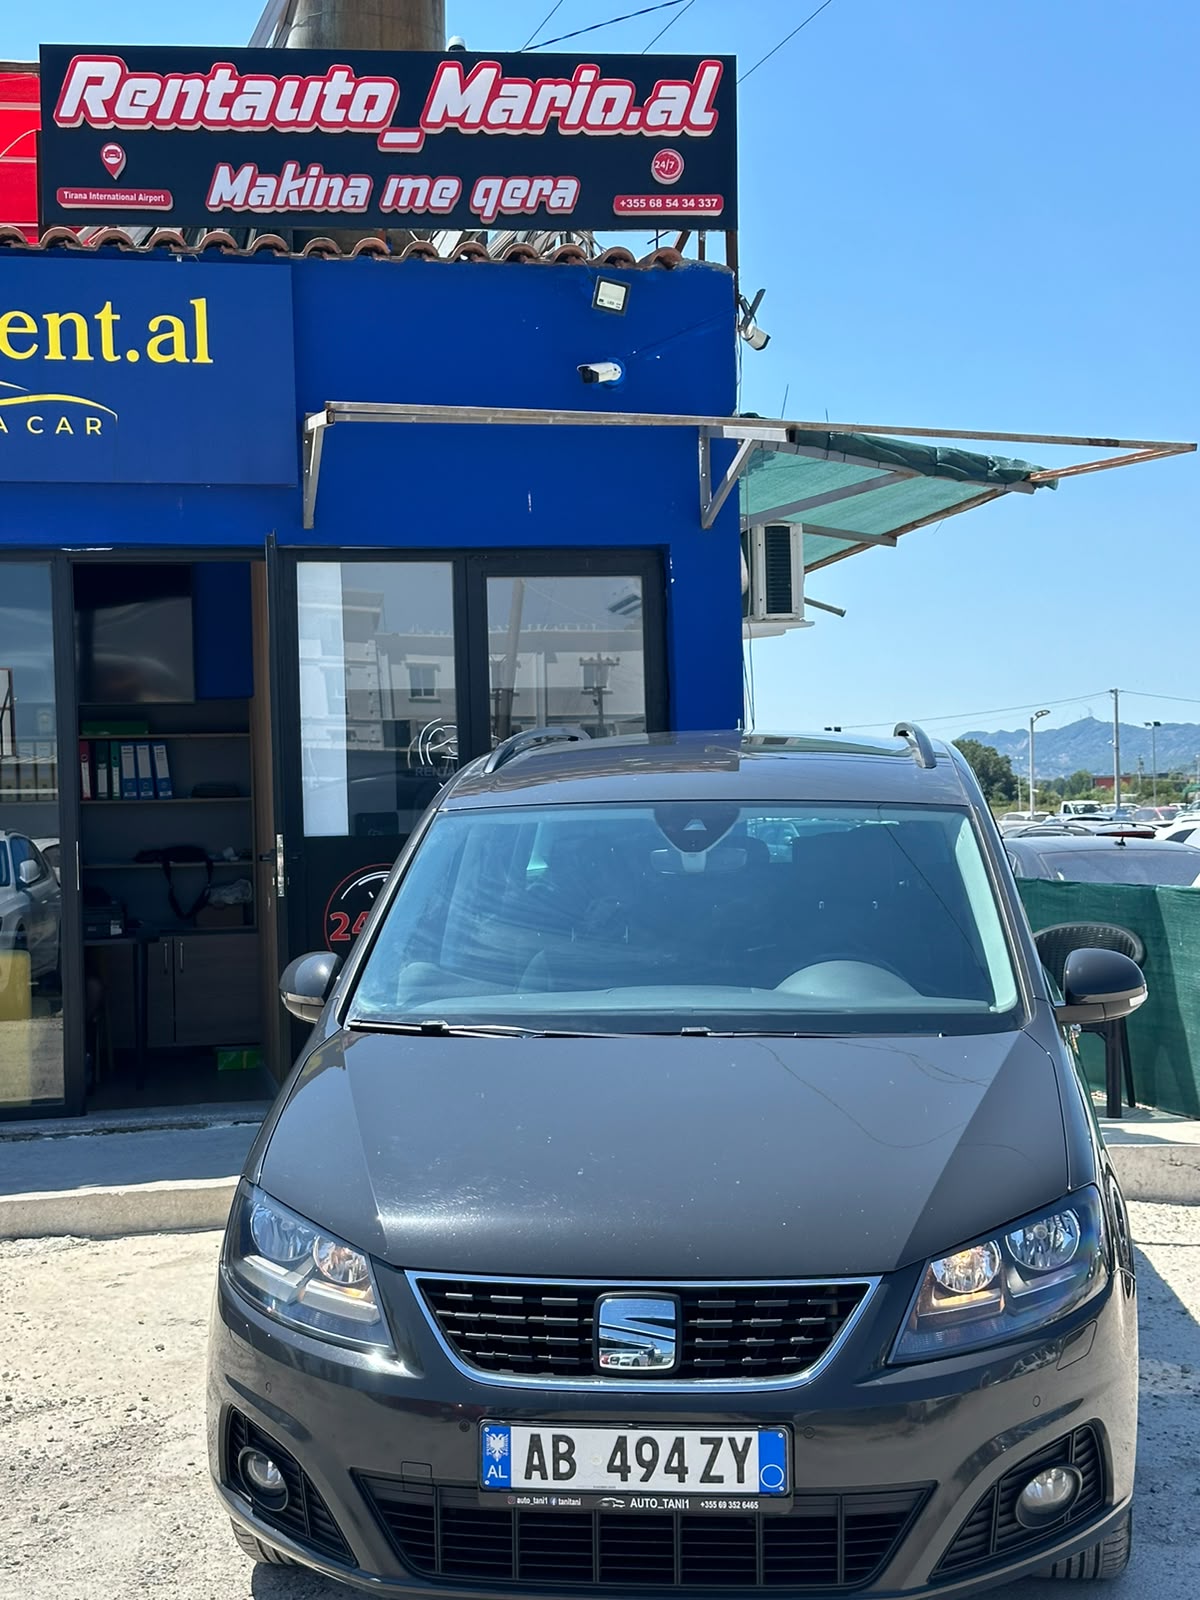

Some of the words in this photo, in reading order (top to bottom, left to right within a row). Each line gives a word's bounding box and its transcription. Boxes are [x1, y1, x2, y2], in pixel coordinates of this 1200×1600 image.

[56, 57, 721, 151] Rentauto_Mario.al
[654, 159, 675, 171] 24/7
[63, 191, 88, 200] Tirana
[89, 192, 137, 201] International
[138, 193, 165, 203] Airport
[206, 162, 372, 209] Makina
[381, 176, 461, 211] me
[471, 177, 579, 221] qera
[620, 199, 646, 208] +355
[649, 199, 662, 208] 68
[666, 199, 679, 208] 54
[682, 199, 695, 208] 34
[698, 199, 718, 208] 337
[26, 415, 103, 435] CAR
[524, 1433, 577, 1481] AB
[487, 1464, 508, 1479] AL
[630, 1497, 689, 1509] AUTO_TANI1
[700, 1500, 717, 1509] +355
[718, 1500, 727, 1509] 69
[728, 1501, 741, 1509] 352
[741, 1501, 759, 1510] 6465
